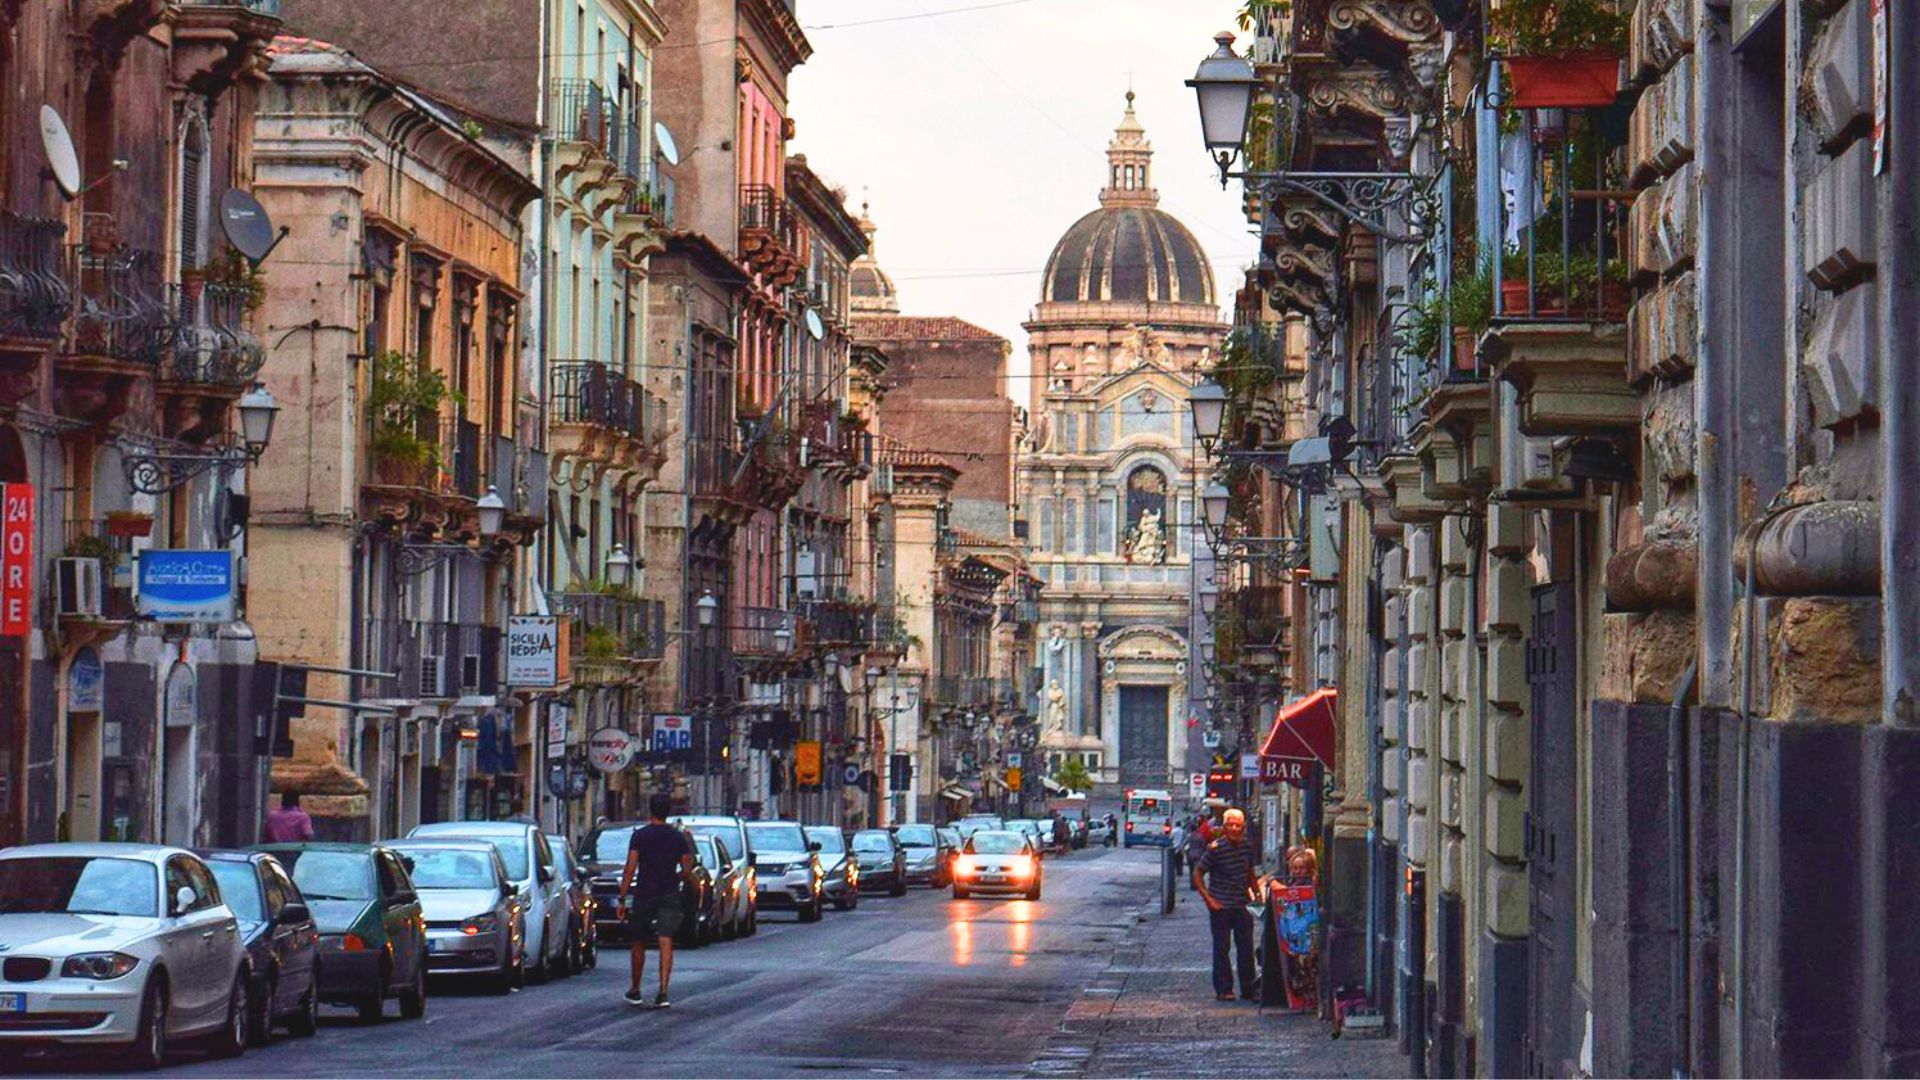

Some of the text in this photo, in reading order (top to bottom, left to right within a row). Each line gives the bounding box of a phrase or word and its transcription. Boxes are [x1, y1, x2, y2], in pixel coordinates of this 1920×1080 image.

[8, 497, 27, 522] 24
[9, 531, 24, 623] ORE
[656, 729, 691, 751] BAR
[1266, 761, 1302, 778] BAR
